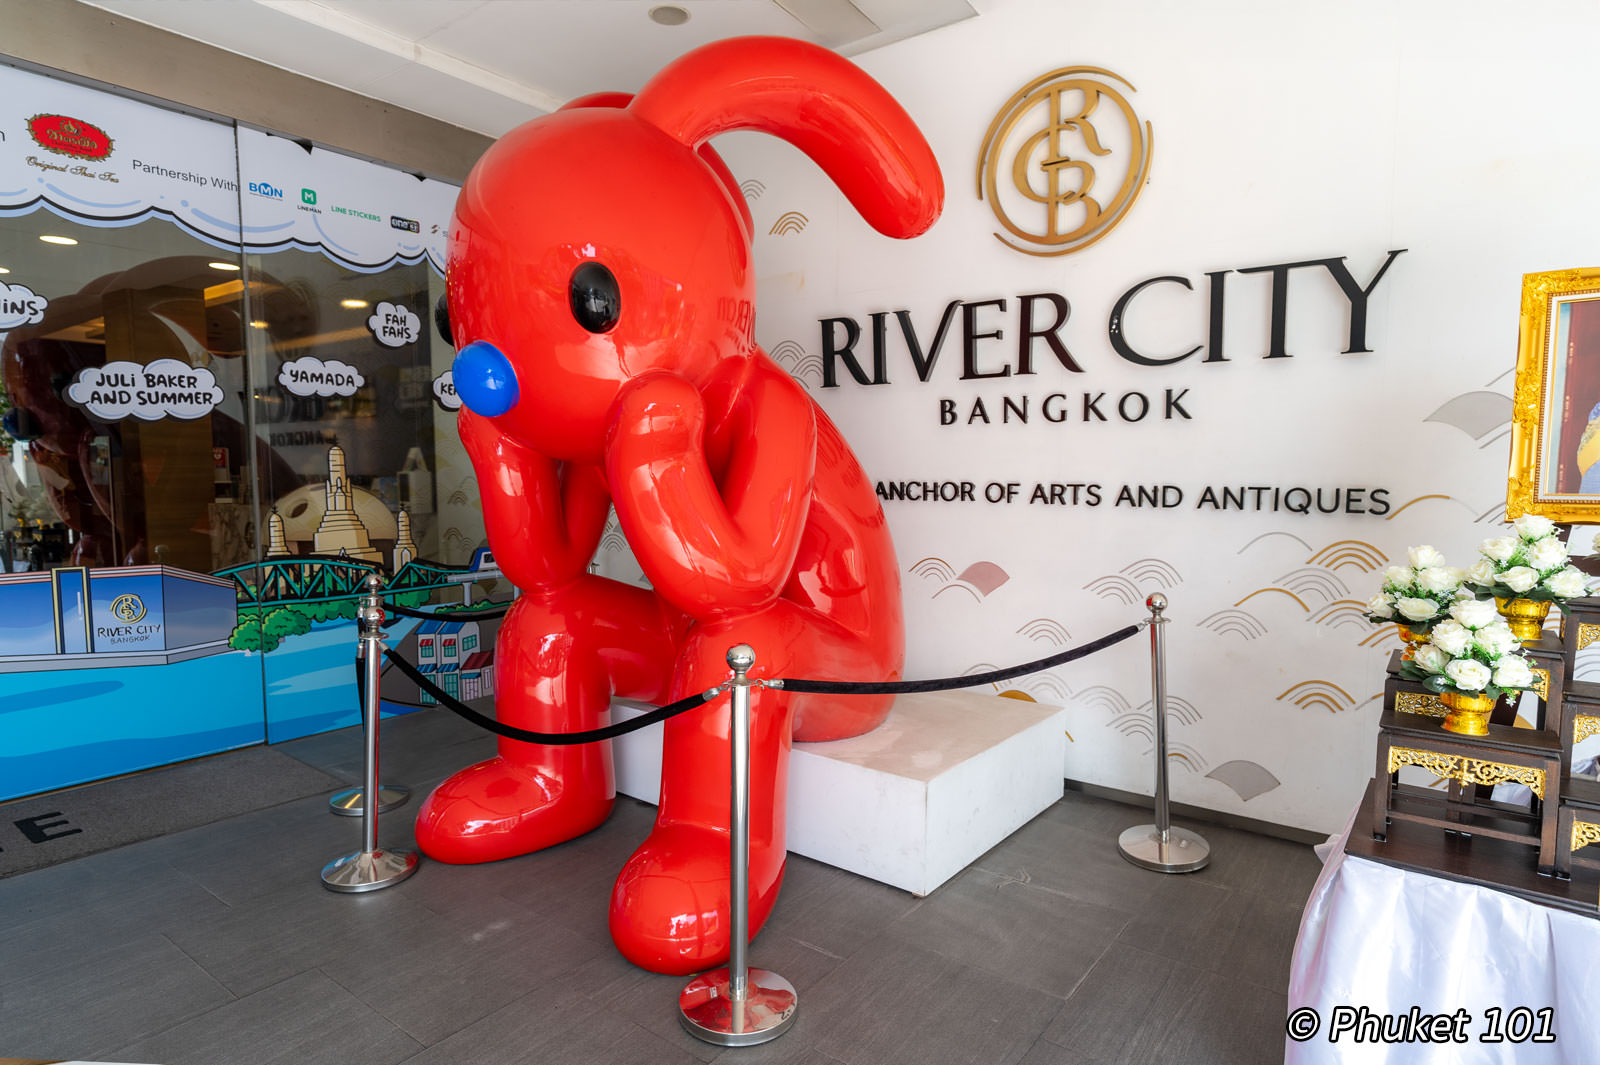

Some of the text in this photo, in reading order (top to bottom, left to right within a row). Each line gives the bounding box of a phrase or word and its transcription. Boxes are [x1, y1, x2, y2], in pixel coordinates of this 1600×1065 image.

[132, 159, 239, 193] Partnership With
[249, 182, 283, 198] BMN
[331, 205, 382, 222] LINE STICKERS
[385, 313, 407, 327] FAH
[818, 291, 1085, 389] RIVER
[1108, 248, 1409, 367] CITY
[382, 326, 412, 339] FAHS
[144, 374, 198, 389] BAKER
[289, 369, 355, 388] YAMADA
[440, 382, 456, 396] KE
[90, 390, 213, 406] AND SUMMER
[939, 388, 1193, 426] BANGKOK
[875, 481, 1391, 516] ANCHOR OF ARTS AND ANTIQUES
[97, 624, 161, 638] RIVER CITY
[110, 634, 151, 646] BANGKOK
